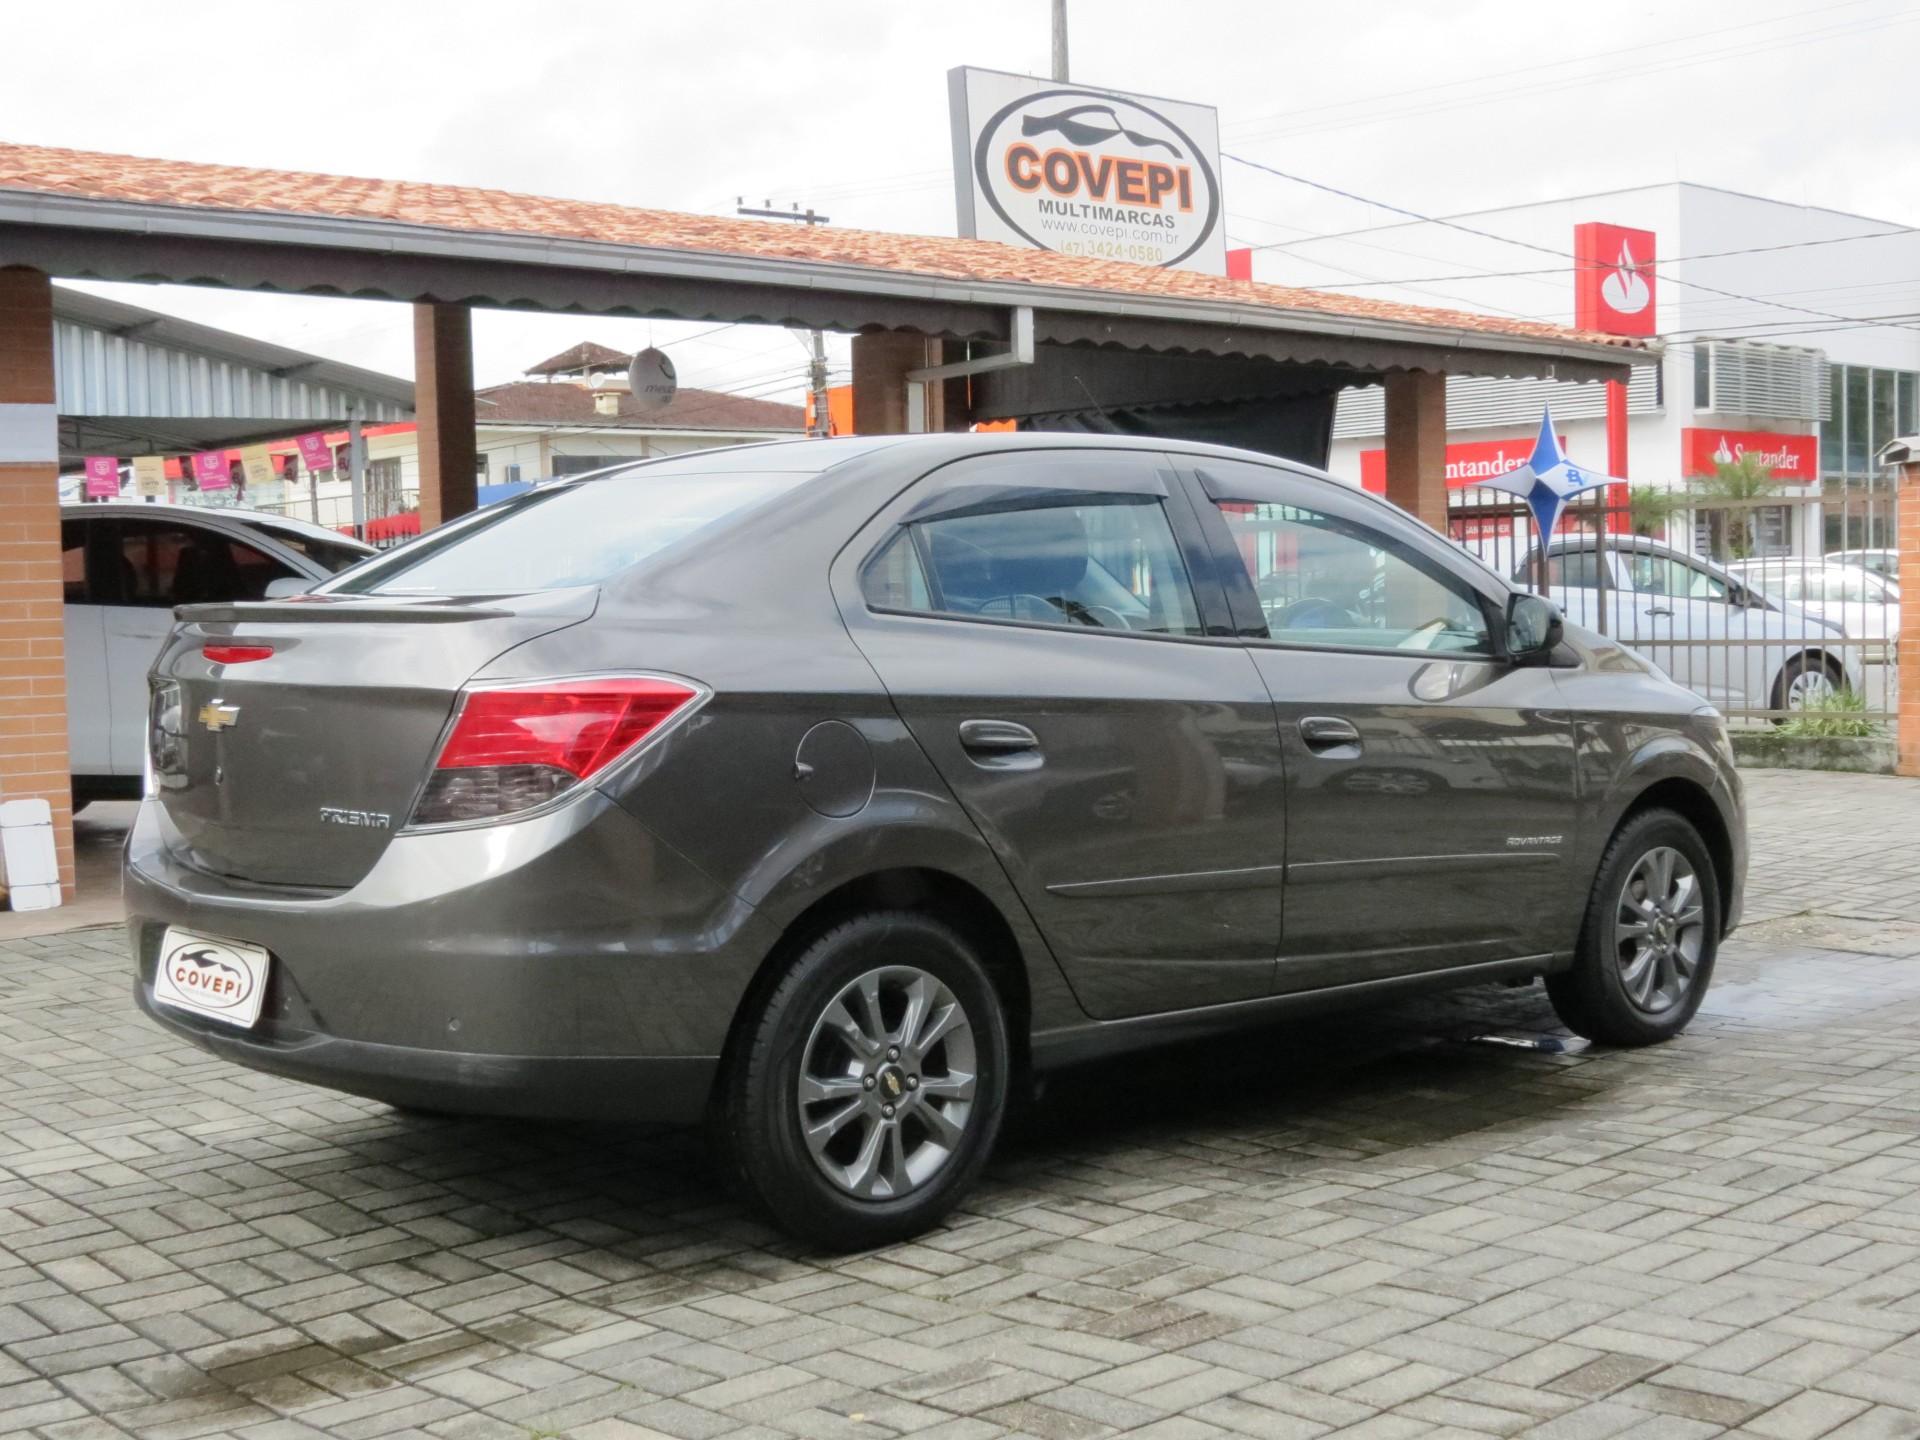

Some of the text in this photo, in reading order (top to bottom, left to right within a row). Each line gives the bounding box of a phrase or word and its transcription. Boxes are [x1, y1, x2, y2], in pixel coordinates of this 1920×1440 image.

[1005, 142, 1194, 213] COVEPI
[1038, 199, 1176, 229] MULTIMARCAS
[1041, 217, 1180, 245] www.covepi.com.br
[1445, 451, 1527, 479] ntander
[319, 807, 391, 829] PRISMA
[175, 966, 243, 999] COVEPI
